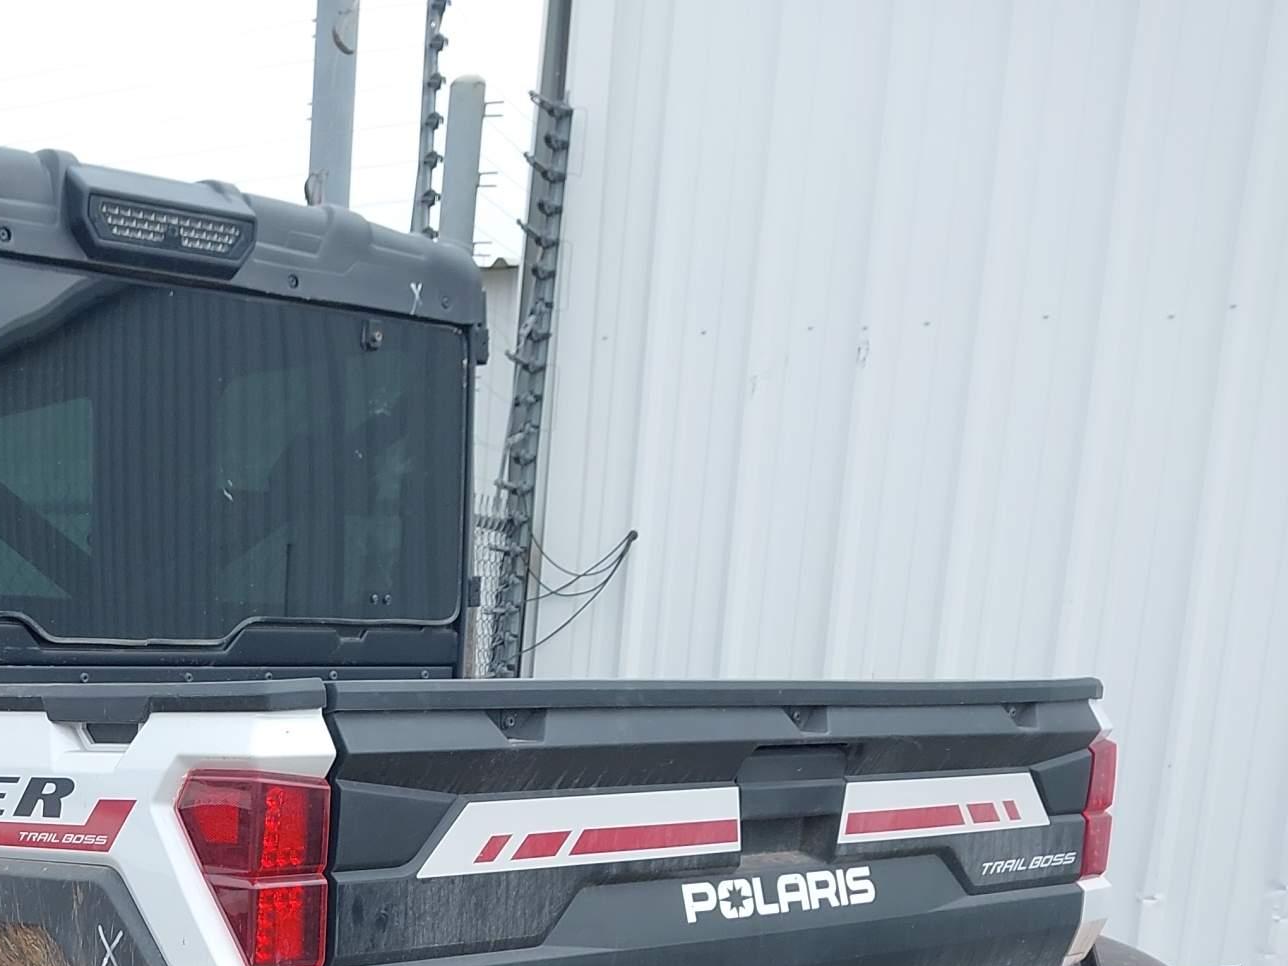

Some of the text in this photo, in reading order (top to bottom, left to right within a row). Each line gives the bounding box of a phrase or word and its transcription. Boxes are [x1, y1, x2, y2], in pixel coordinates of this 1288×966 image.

[18, 831, 109, 846] TRAIL BOSS
[980, 851, 1077, 877] TRAIL BOSS
[680, 865, 877, 925] POLARIS
